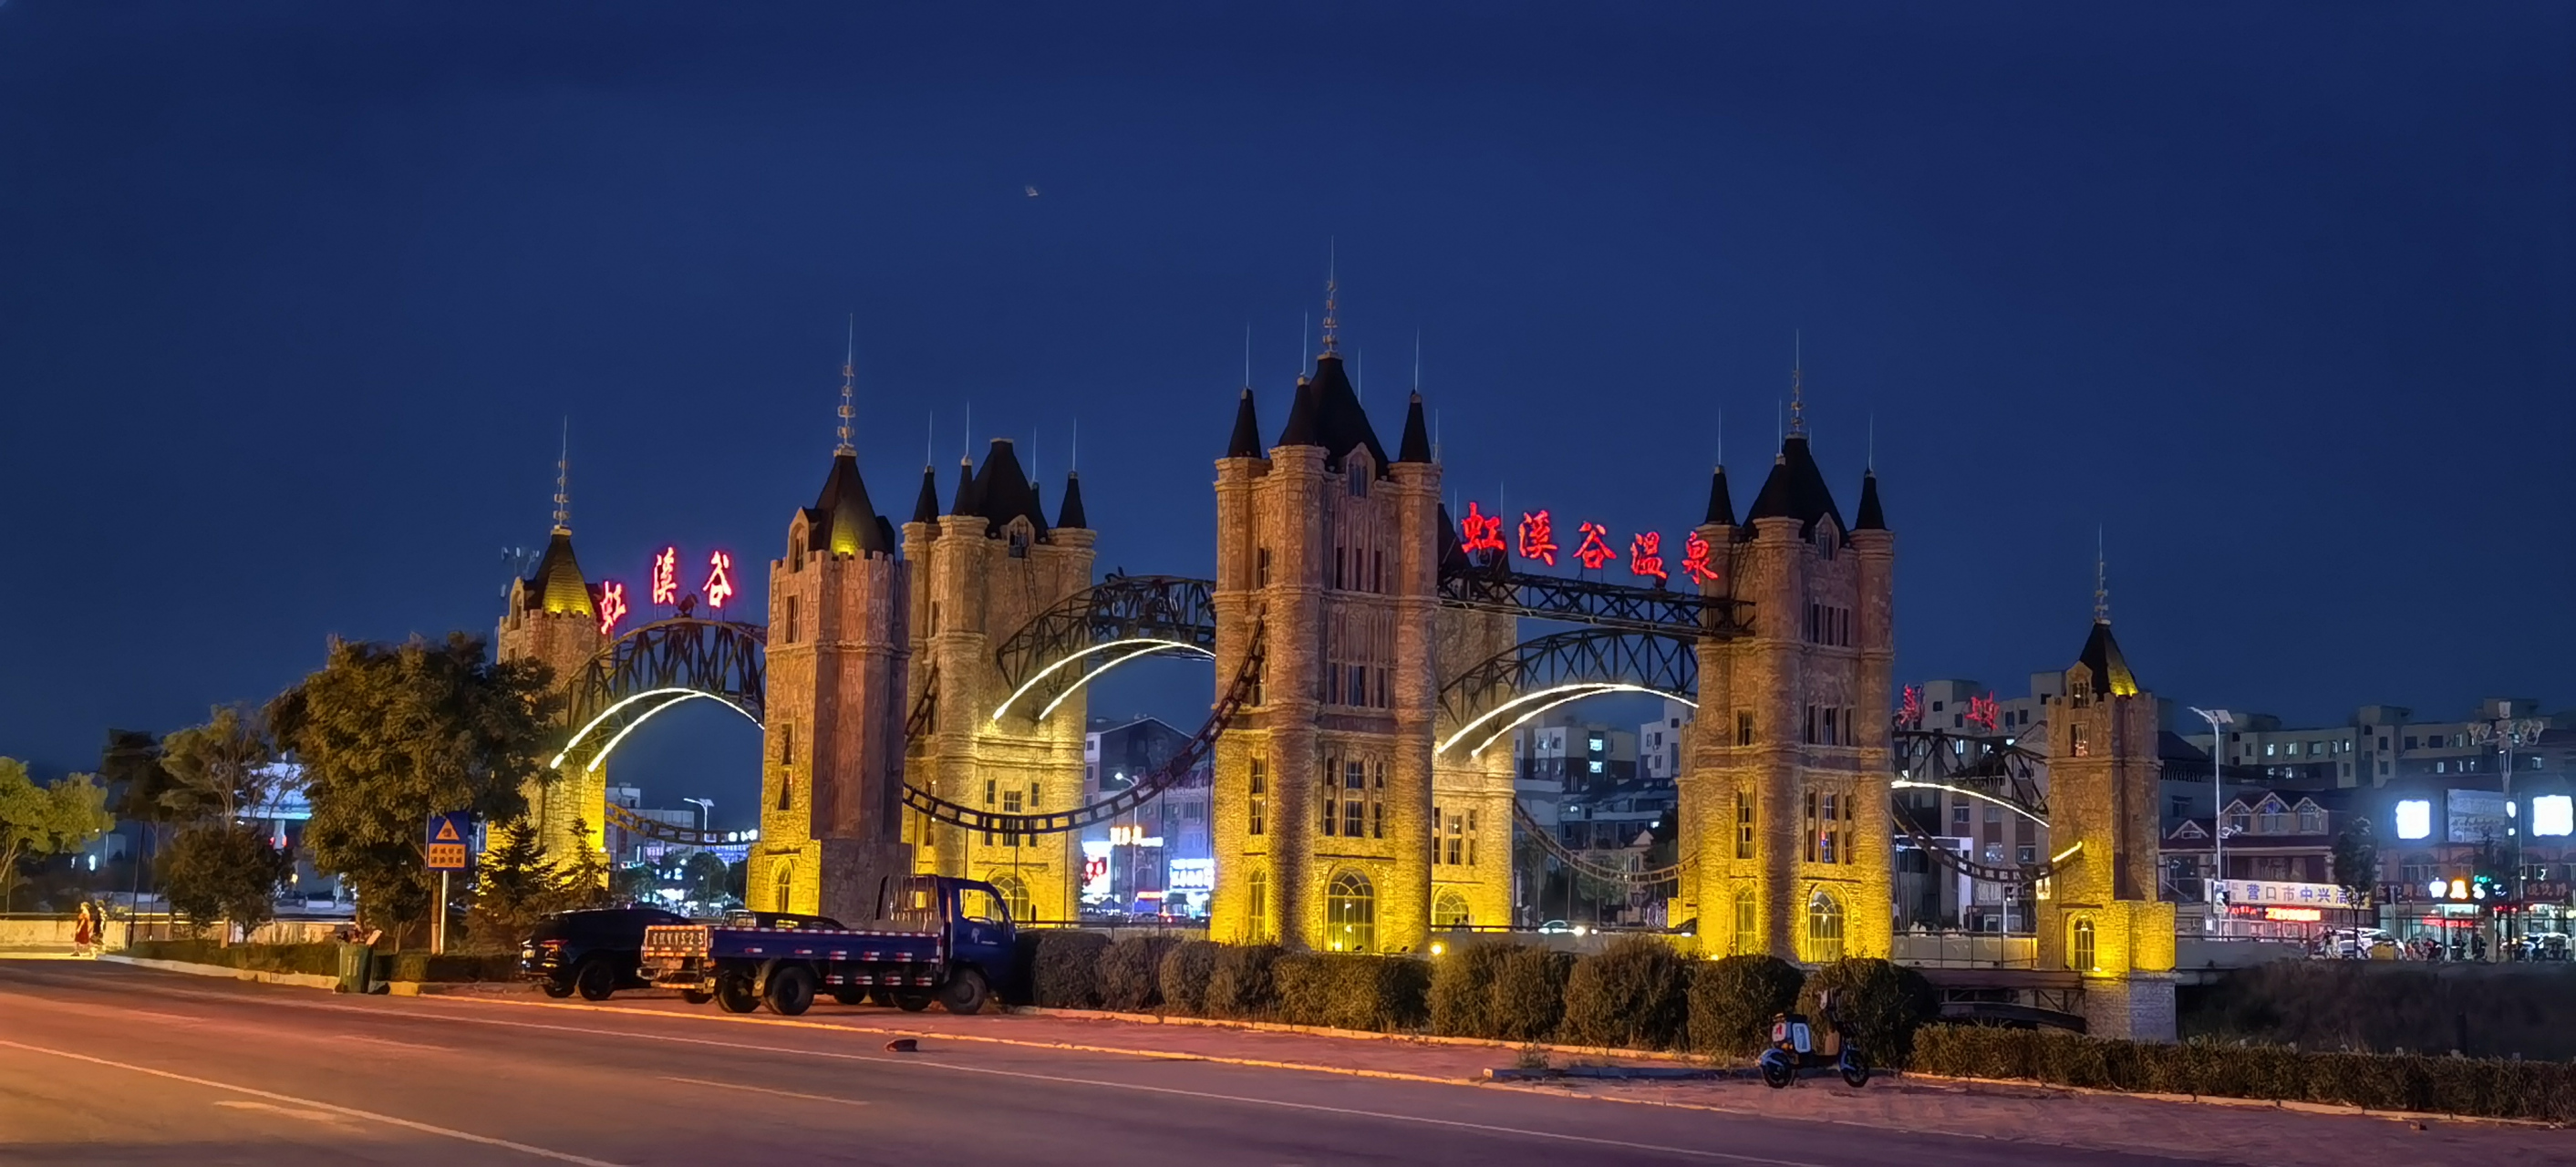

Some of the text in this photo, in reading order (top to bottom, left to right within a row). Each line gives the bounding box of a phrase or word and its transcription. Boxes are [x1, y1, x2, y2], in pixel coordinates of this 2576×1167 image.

[1461, 501, 1719, 584] 虹溪谷温泉
[600, 546, 732, 635] 虹溪谷
[2247, 883, 2364, 904] 营口市中兴洁
